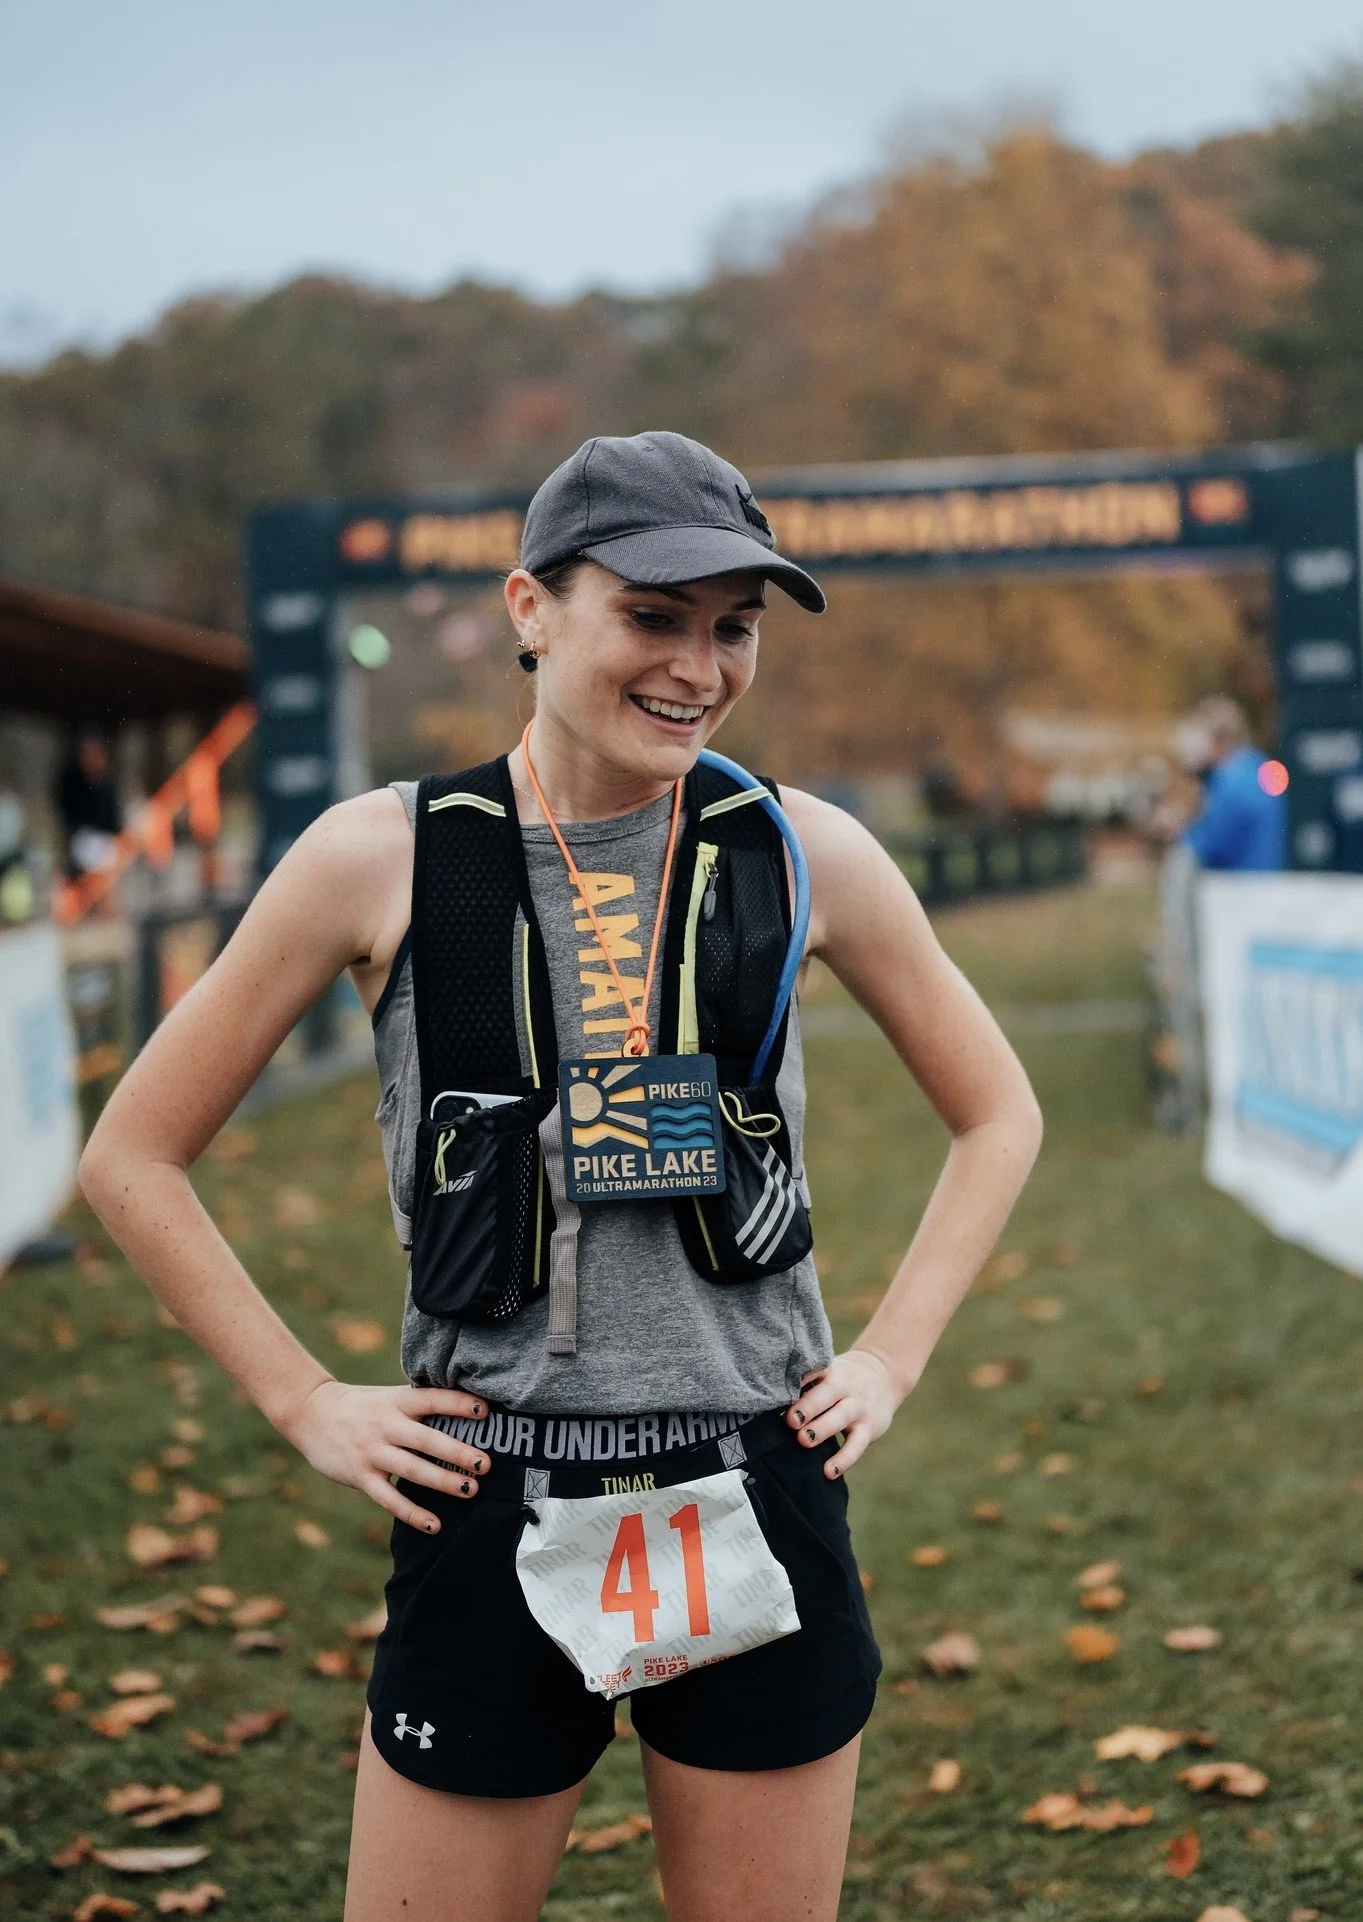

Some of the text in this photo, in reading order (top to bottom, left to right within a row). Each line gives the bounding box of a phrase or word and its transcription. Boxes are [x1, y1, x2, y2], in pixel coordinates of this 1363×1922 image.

[568, 871, 646, 1059] AMAT
[573, 1149, 717, 1180] PIKE LAKE
[576, 1175, 717, 1194] 20 ULTRAMARATHON 23
[543, 1412, 661, 1461] UNDER
[601, 1472, 655, 1496] TINAR
[600, 1503, 711, 1643] 41
[644, 1654, 688, 1665] PIKE LAKE
[644, 1662, 689, 1677] 2023
[597, 1670, 621, 1684] LEET
